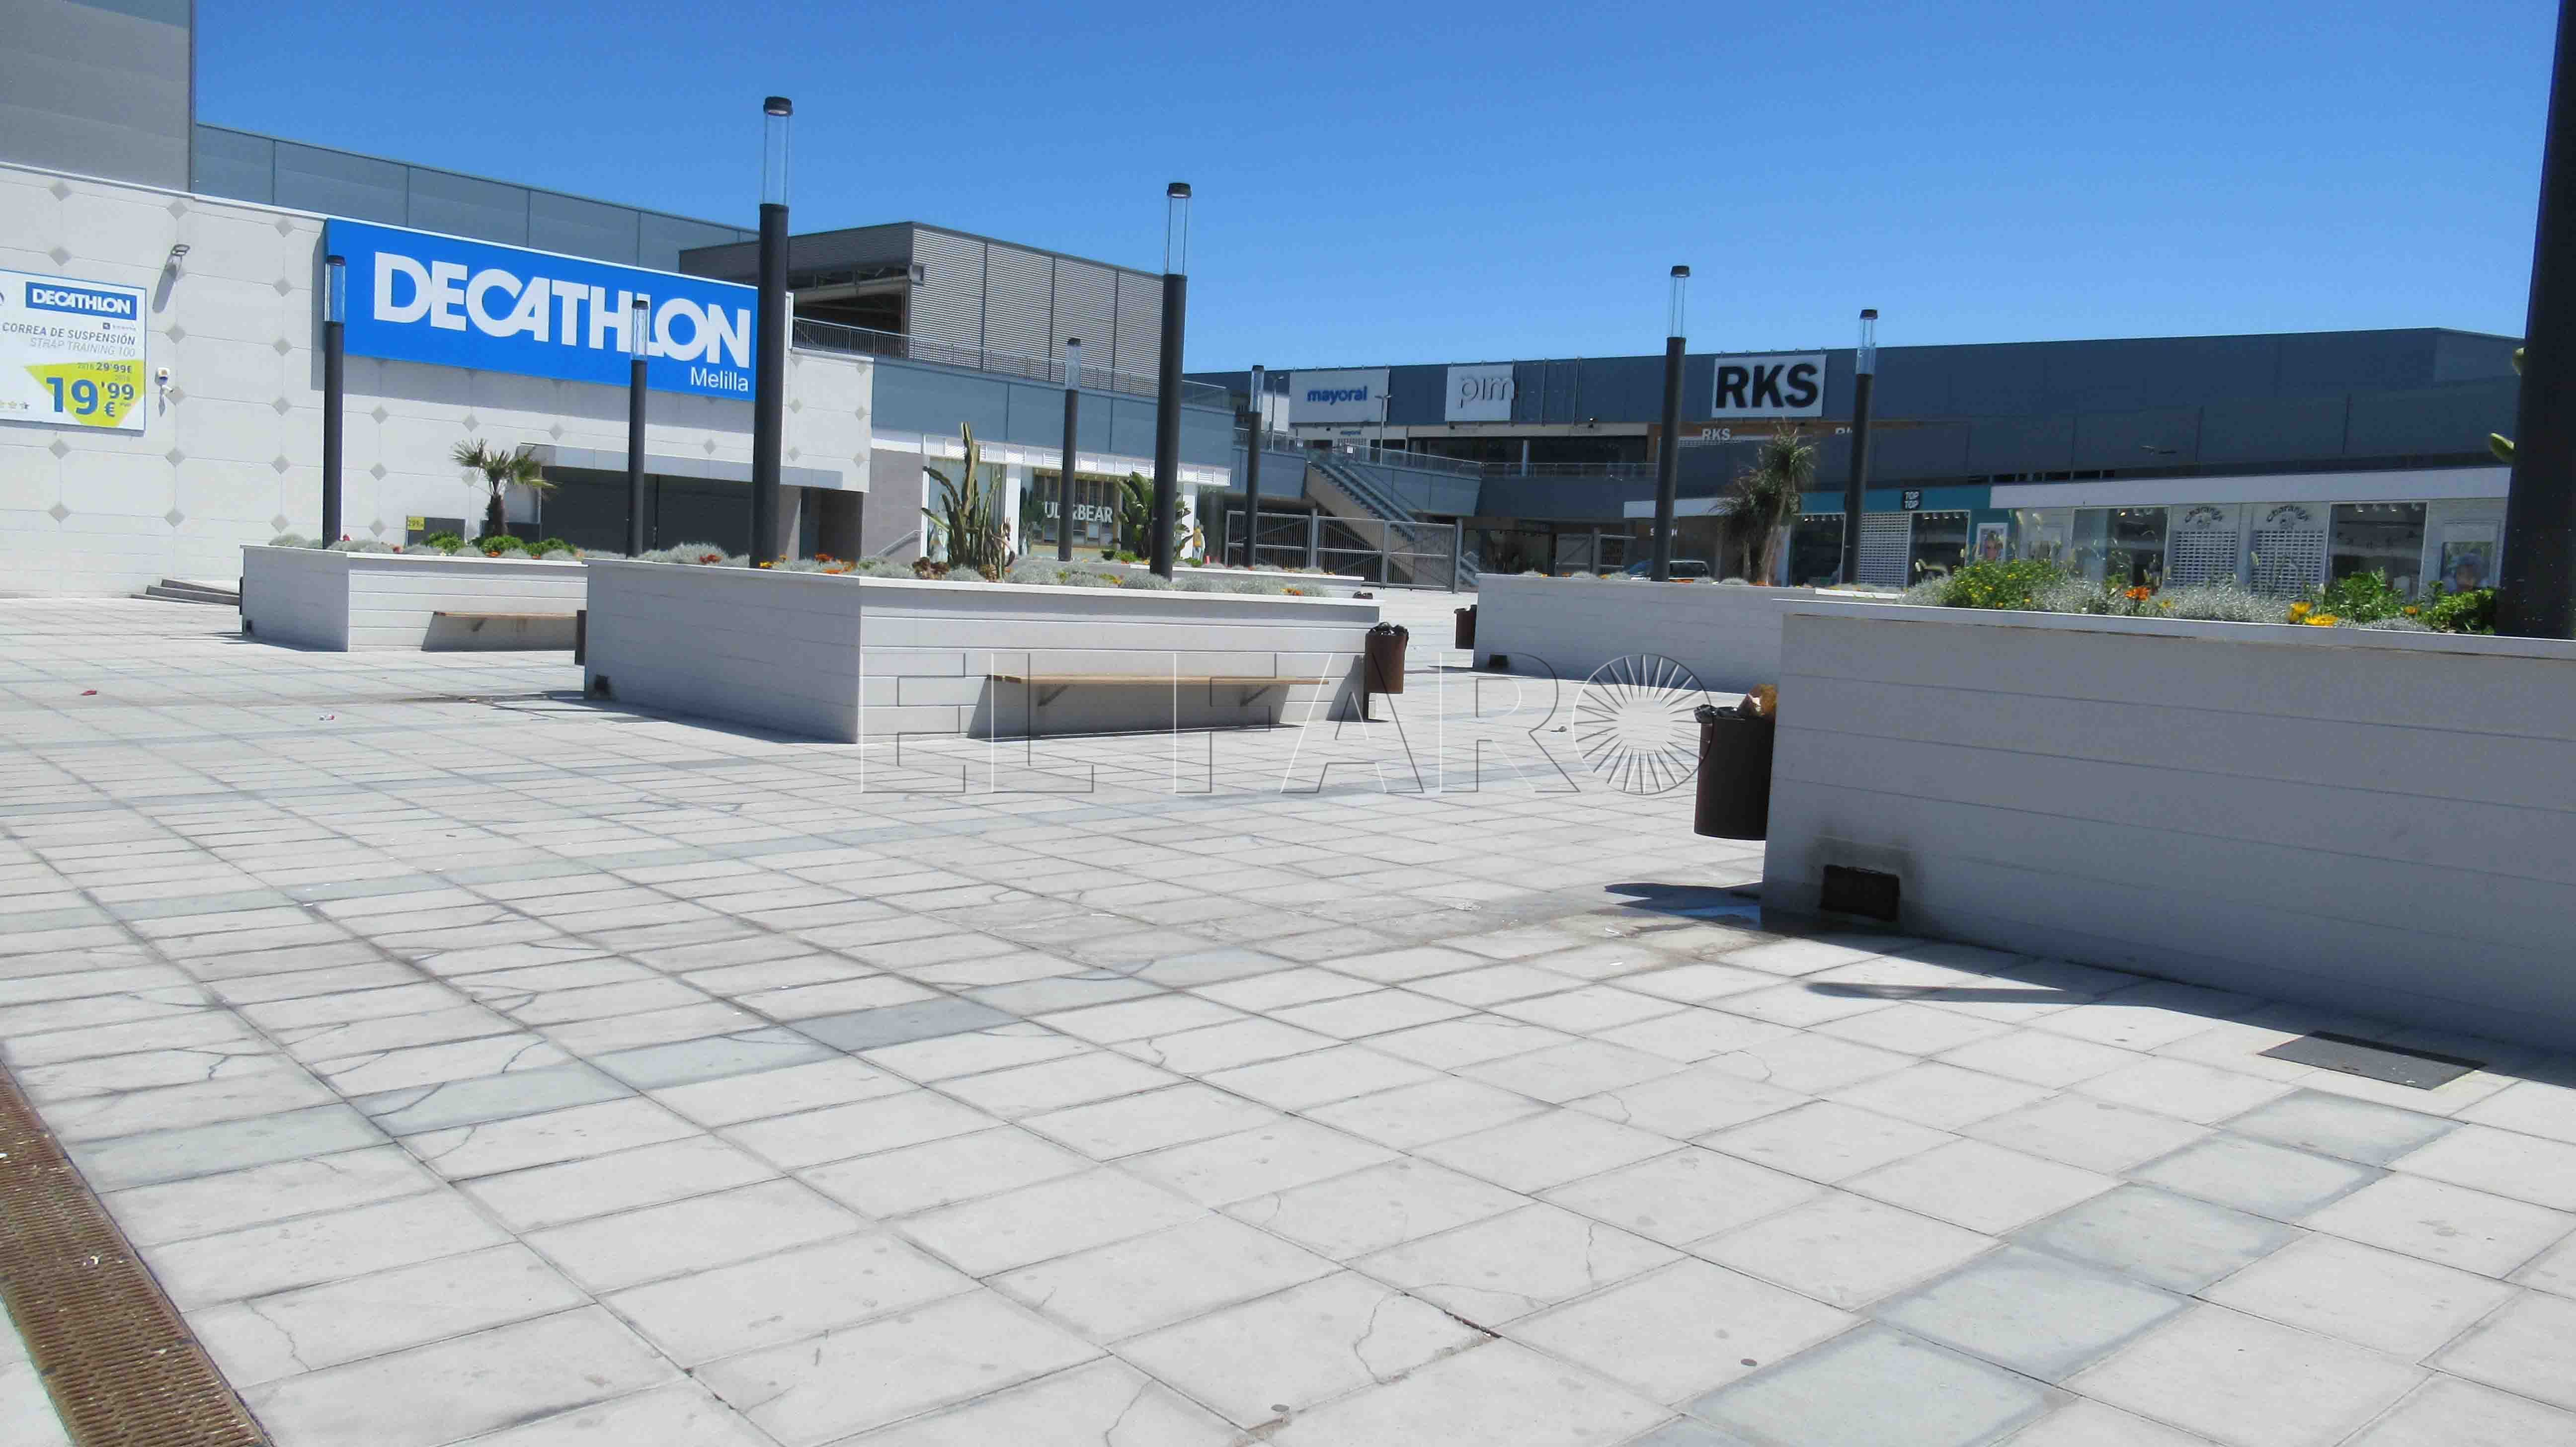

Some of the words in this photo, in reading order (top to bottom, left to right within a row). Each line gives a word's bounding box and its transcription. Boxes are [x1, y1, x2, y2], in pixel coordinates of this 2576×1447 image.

[32, 288, 131, 315] DECATHLON
[373, 251, 751, 368] DECATHLON
[2, 322, 47, 335] CORREA
[51, 327, 65, 337] DE
[30, 337, 65, 349] STRAP
[67, 341, 115, 356] TRAINING
[119, 346, 135, 357] 100
[691, 366, 748, 393] Melilla
[1715, 363, 1818, 408] RKS
[1307, 385, 1368, 405] mayoral
[1701, 428, 1731, 441] RKS
